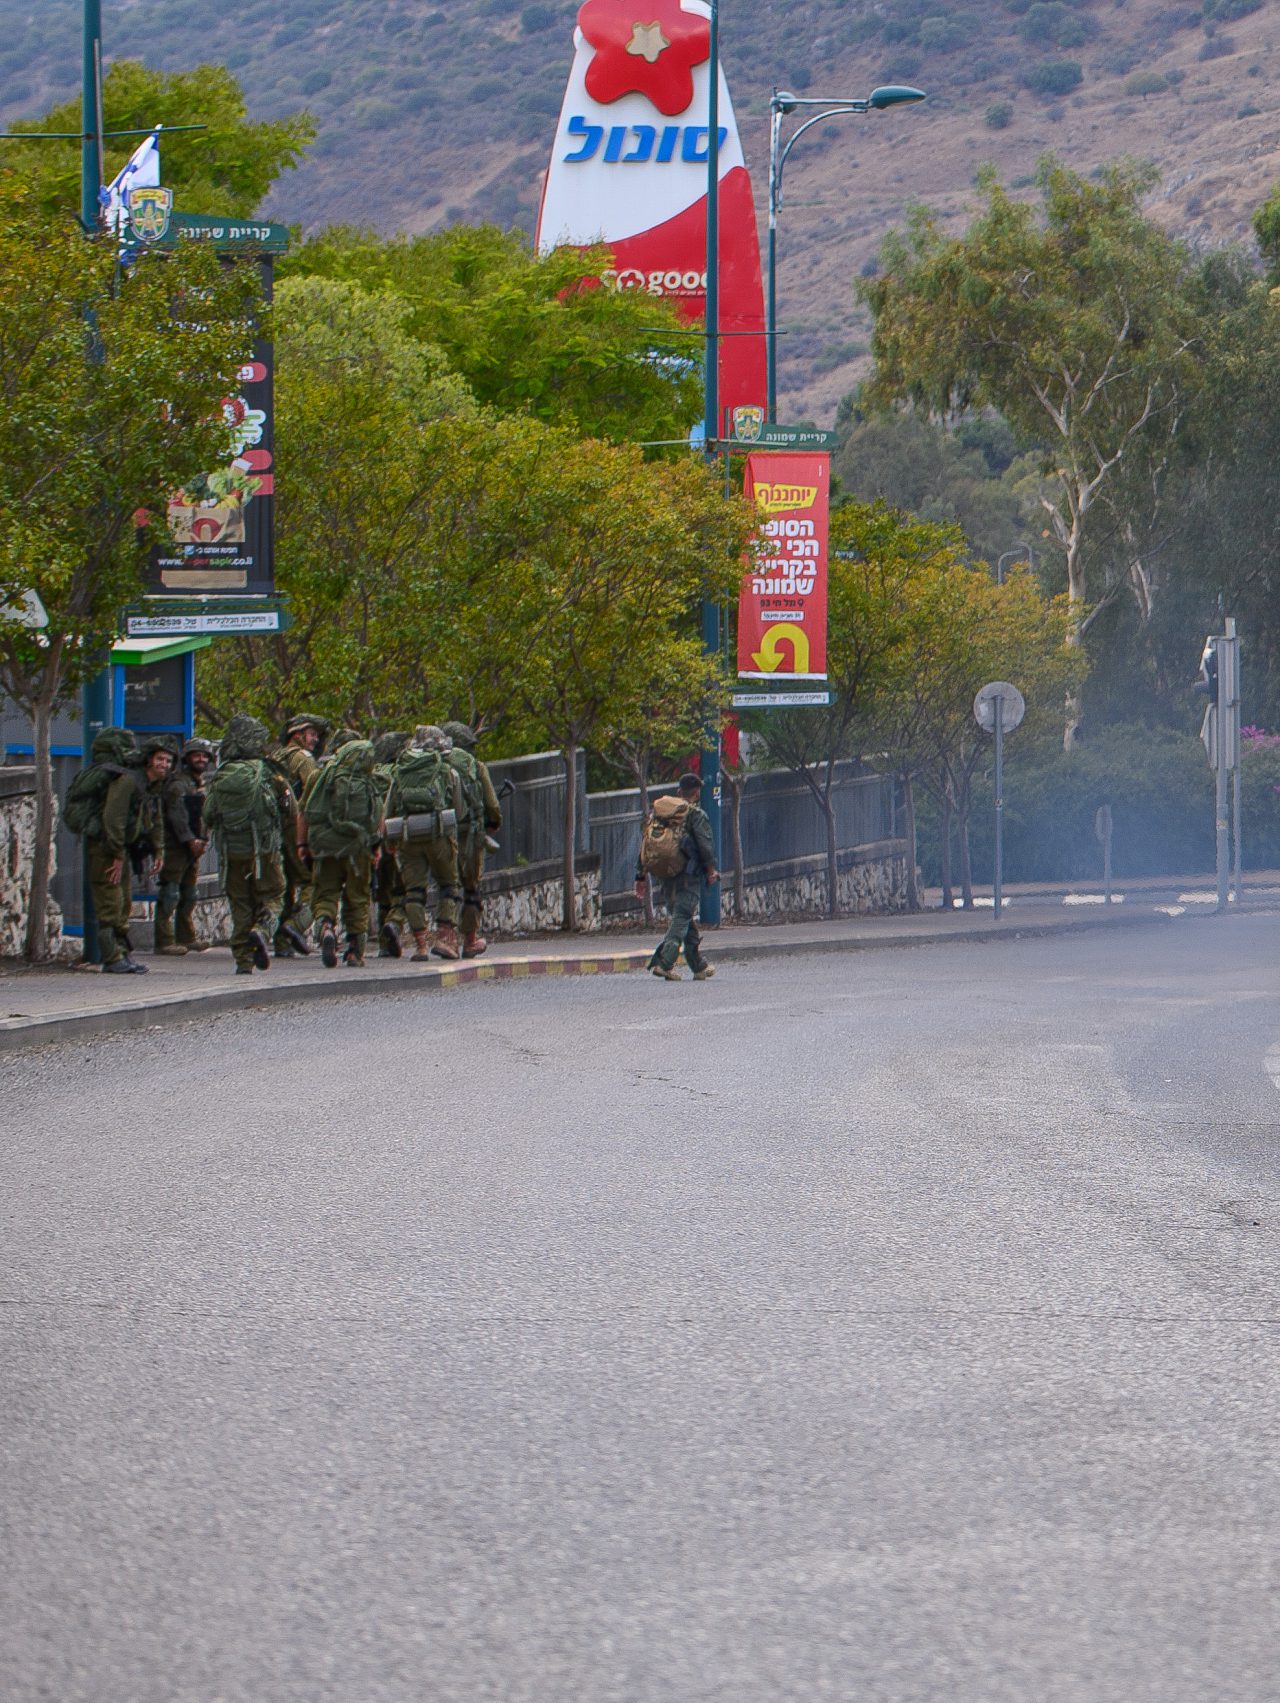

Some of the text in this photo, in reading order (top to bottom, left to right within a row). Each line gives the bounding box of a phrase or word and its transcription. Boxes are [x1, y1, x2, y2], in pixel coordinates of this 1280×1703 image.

[562, 116, 728, 162] סונול
[228, 226, 271, 241] קריית
[647, 270, 708, 297] goo
[765, 432, 827, 444] קריית שמונה
[758, 486, 811, 506] יוחננוף
[786, 539, 820, 557] הכי
[751, 578, 815, 595] שמונה
